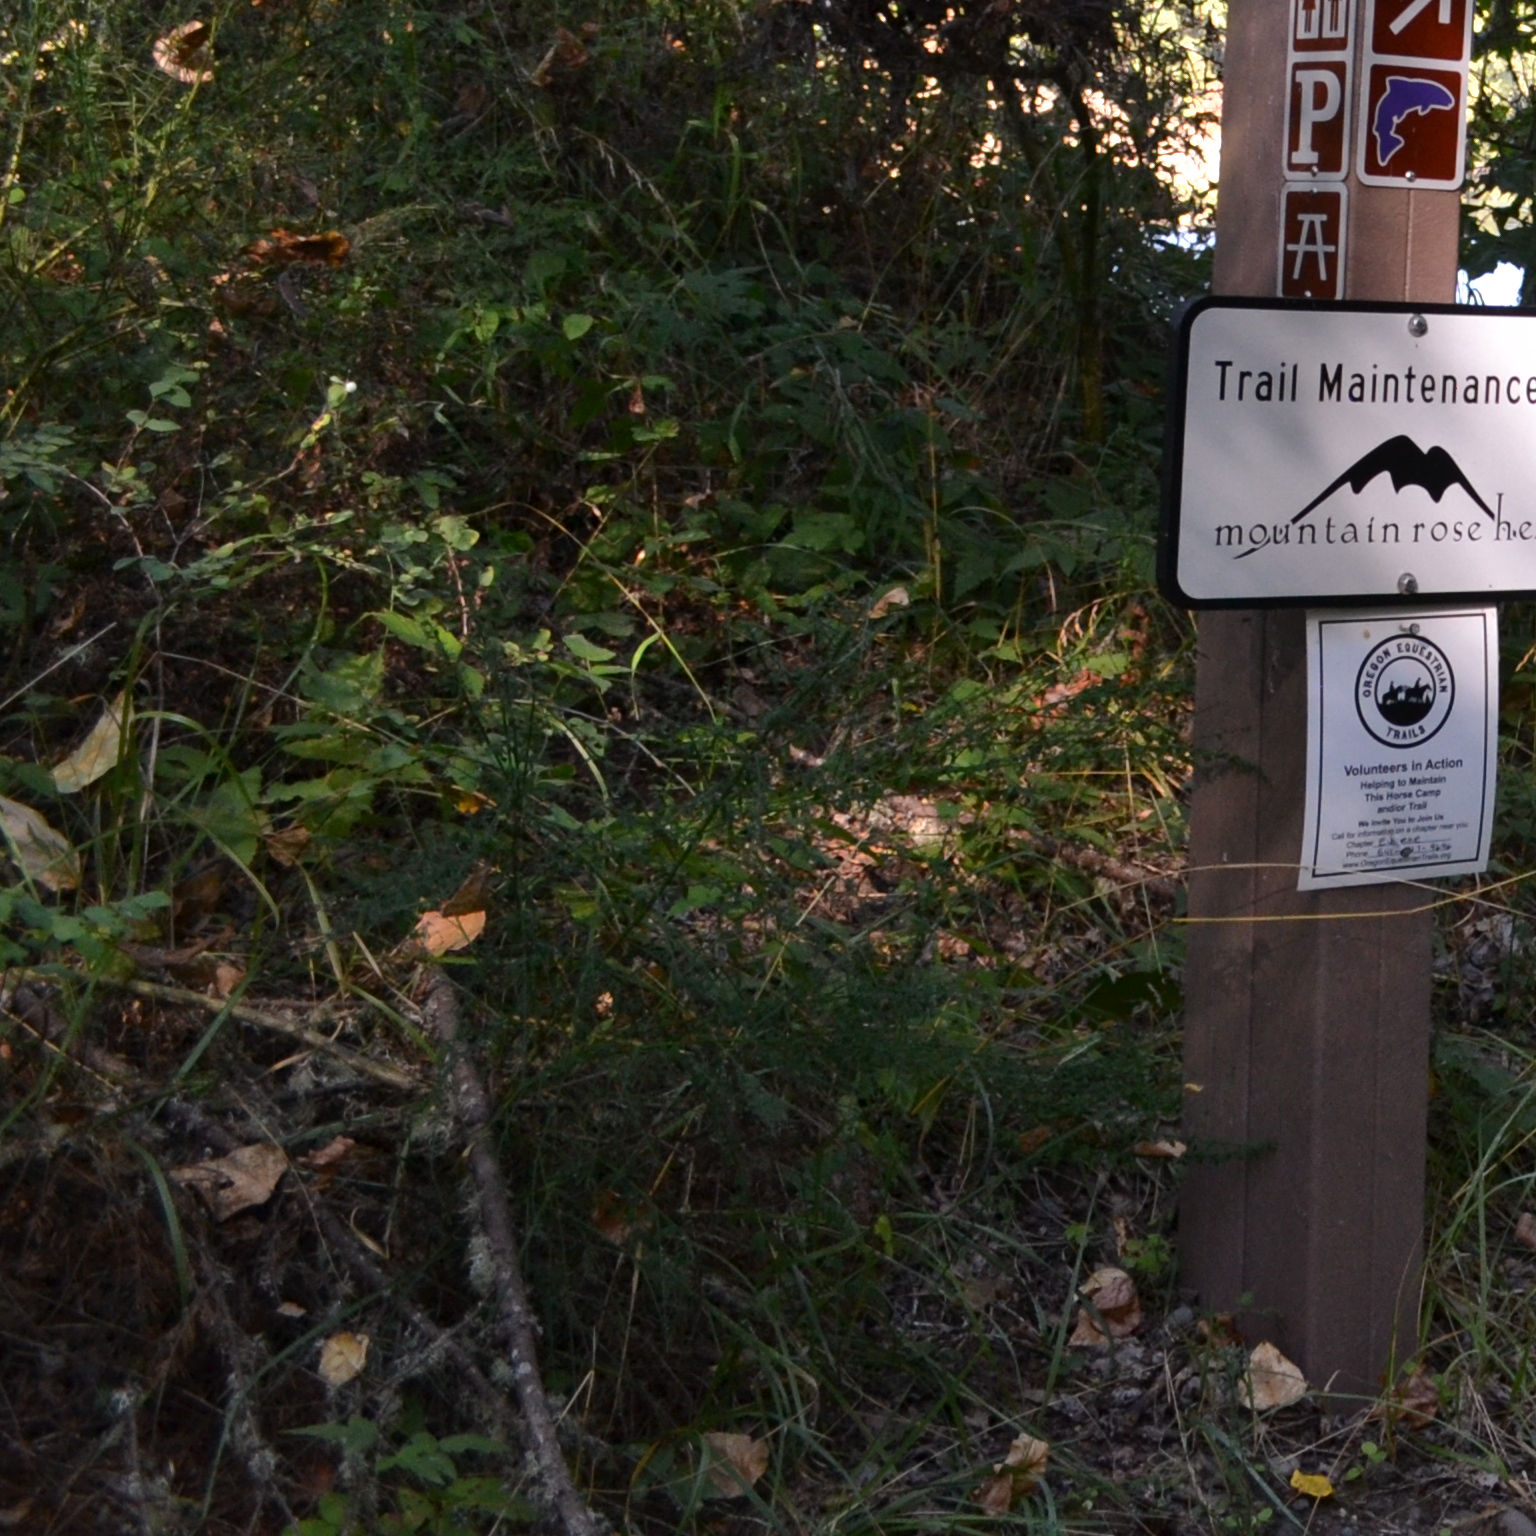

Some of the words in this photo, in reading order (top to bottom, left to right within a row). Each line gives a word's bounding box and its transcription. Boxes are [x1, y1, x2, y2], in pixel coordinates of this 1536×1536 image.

[1214, 360, 1299, 402] Trail
[1214, 516, 1401, 560] mountain
[1412, 520, 1483, 543] rose
[1362, 648, 1392, 698] OREGON
[1396, 642, 1448, 694] EQUESTRIAN
[1386, 724, 1427, 740] TRAILS
[1344, 762, 1408, 777] Volunteers
[1425, 757, 1464, 771] Action
[1360, 779, 1396, 790] Helping
[1397, 779, 1407, 787] to
[1408, 775, 1447, 786] Maintain
[1364, 793, 1384, 802] This
[1386, 791, 1413, 801] Horse
[1415, 789, 1442, 799] Camp
[1377, 804, 1406, 814] and/or
[1408, 801, 1428, 811] Trail
[1393, 817, 1407, 825] You
[1417, 814, 1432, 822] Join
[1434, 813, 1444, 821] Us
[1331, 832, 1344, 841] Call
[1346, 831, 1355, 839] for
[1412, 824, 1438, 834] chapter
[1456, 821, 1469, 831] you
